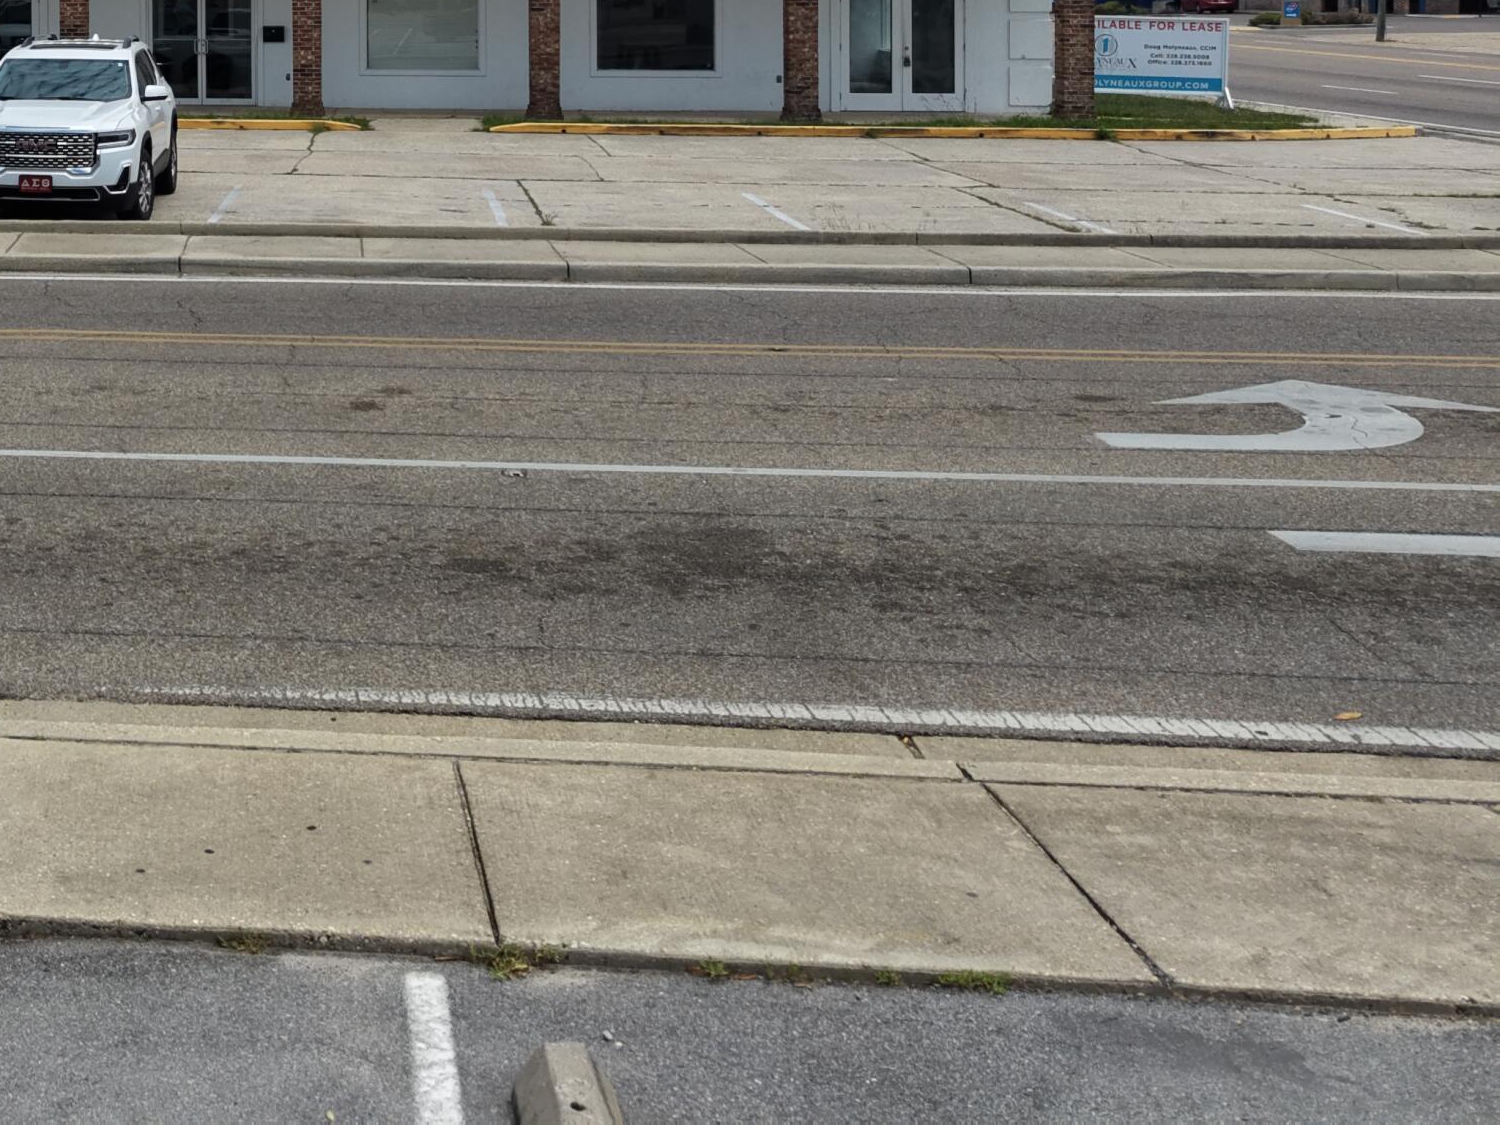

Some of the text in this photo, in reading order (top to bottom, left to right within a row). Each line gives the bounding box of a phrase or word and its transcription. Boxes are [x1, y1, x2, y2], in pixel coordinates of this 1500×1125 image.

[1094, 19, 1222, 32] ILABLE FOR LEASE
